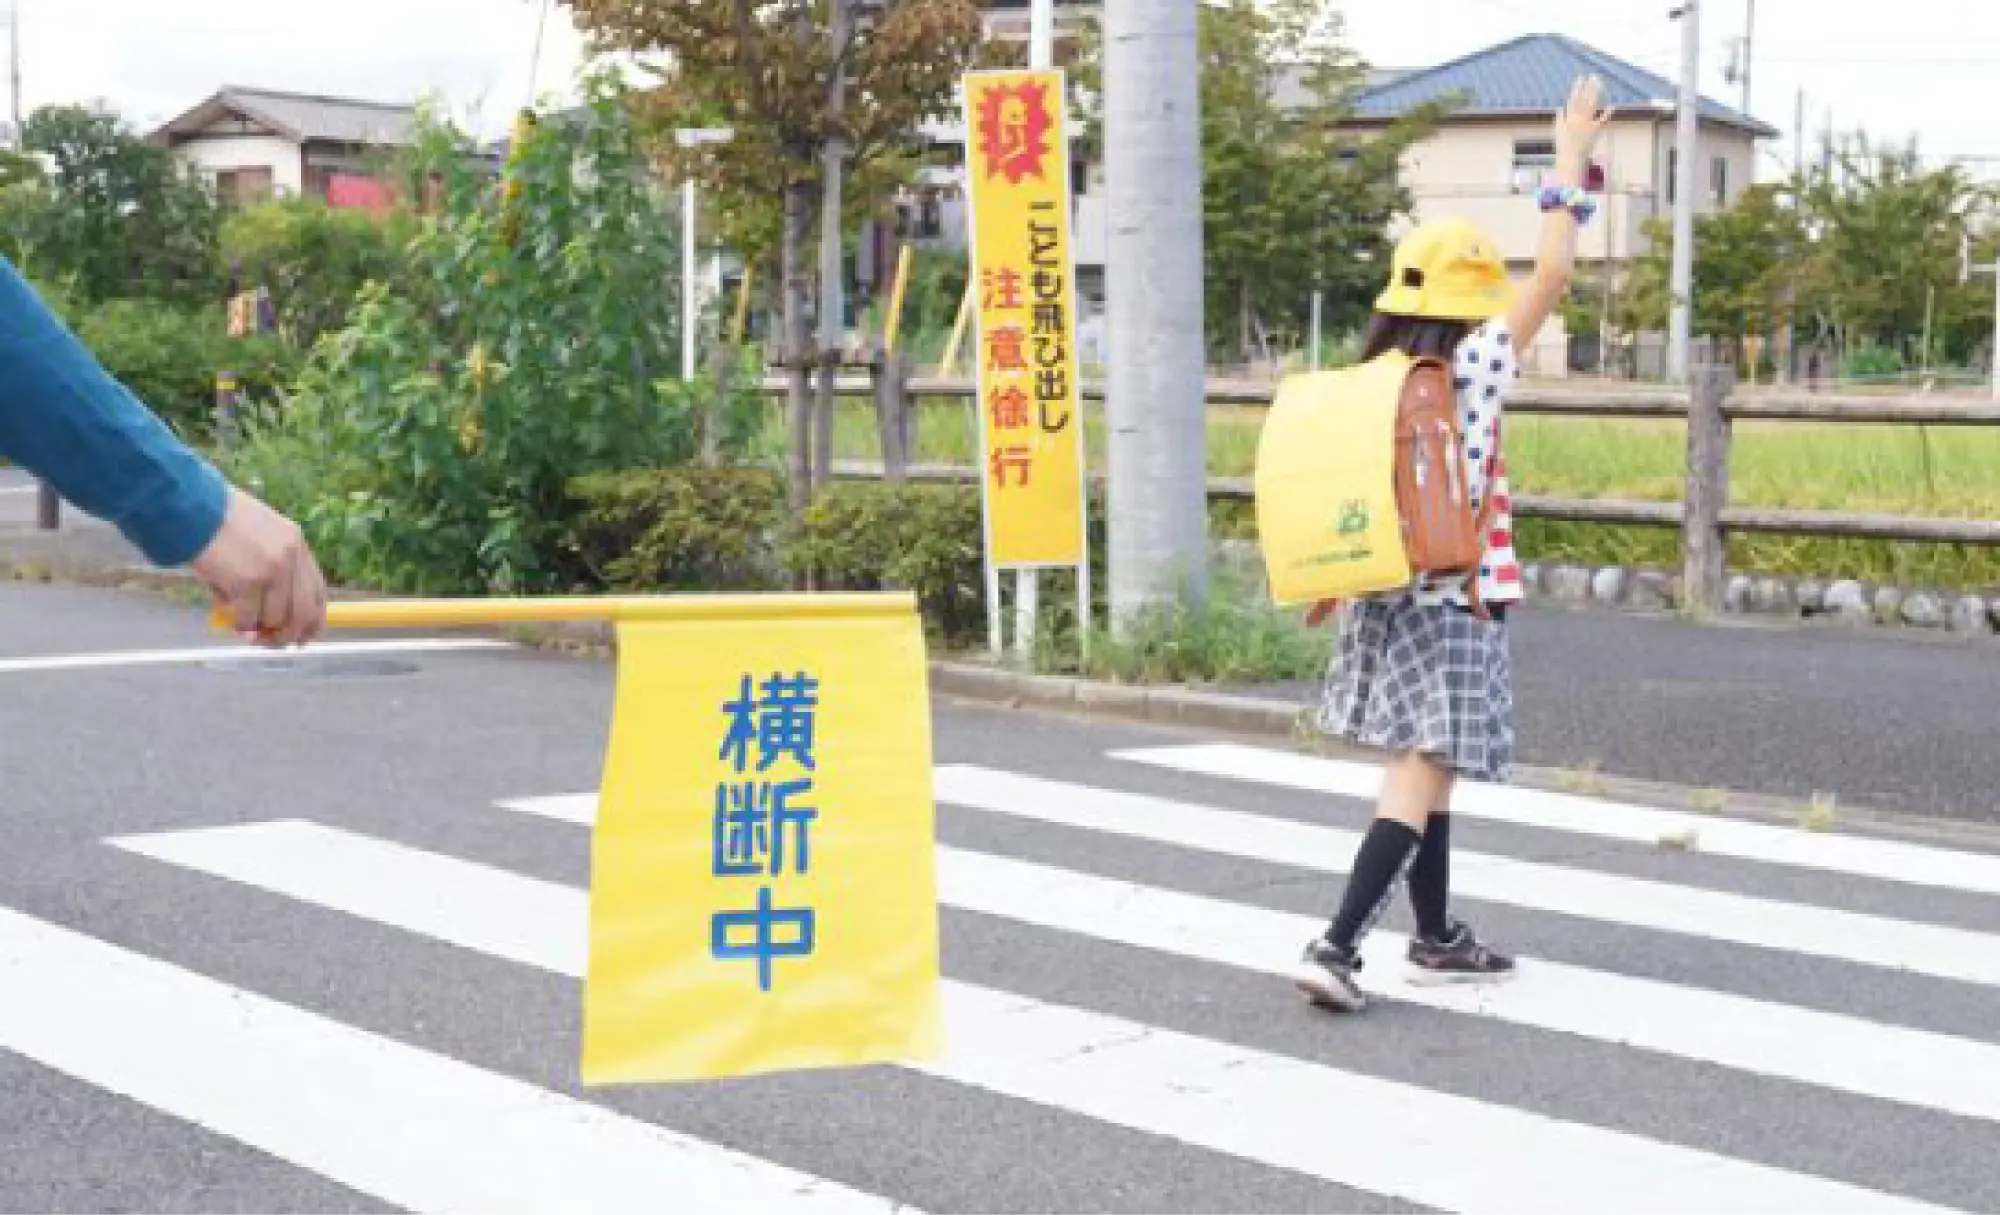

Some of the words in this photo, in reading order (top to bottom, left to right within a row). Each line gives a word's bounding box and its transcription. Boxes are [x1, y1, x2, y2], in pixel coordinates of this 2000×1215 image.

[981, 266, 1031, 489] 注意徐行
[1027, 200, 1069, 433] こども飛び出し
[711, 672, 818, 991] 横断中
